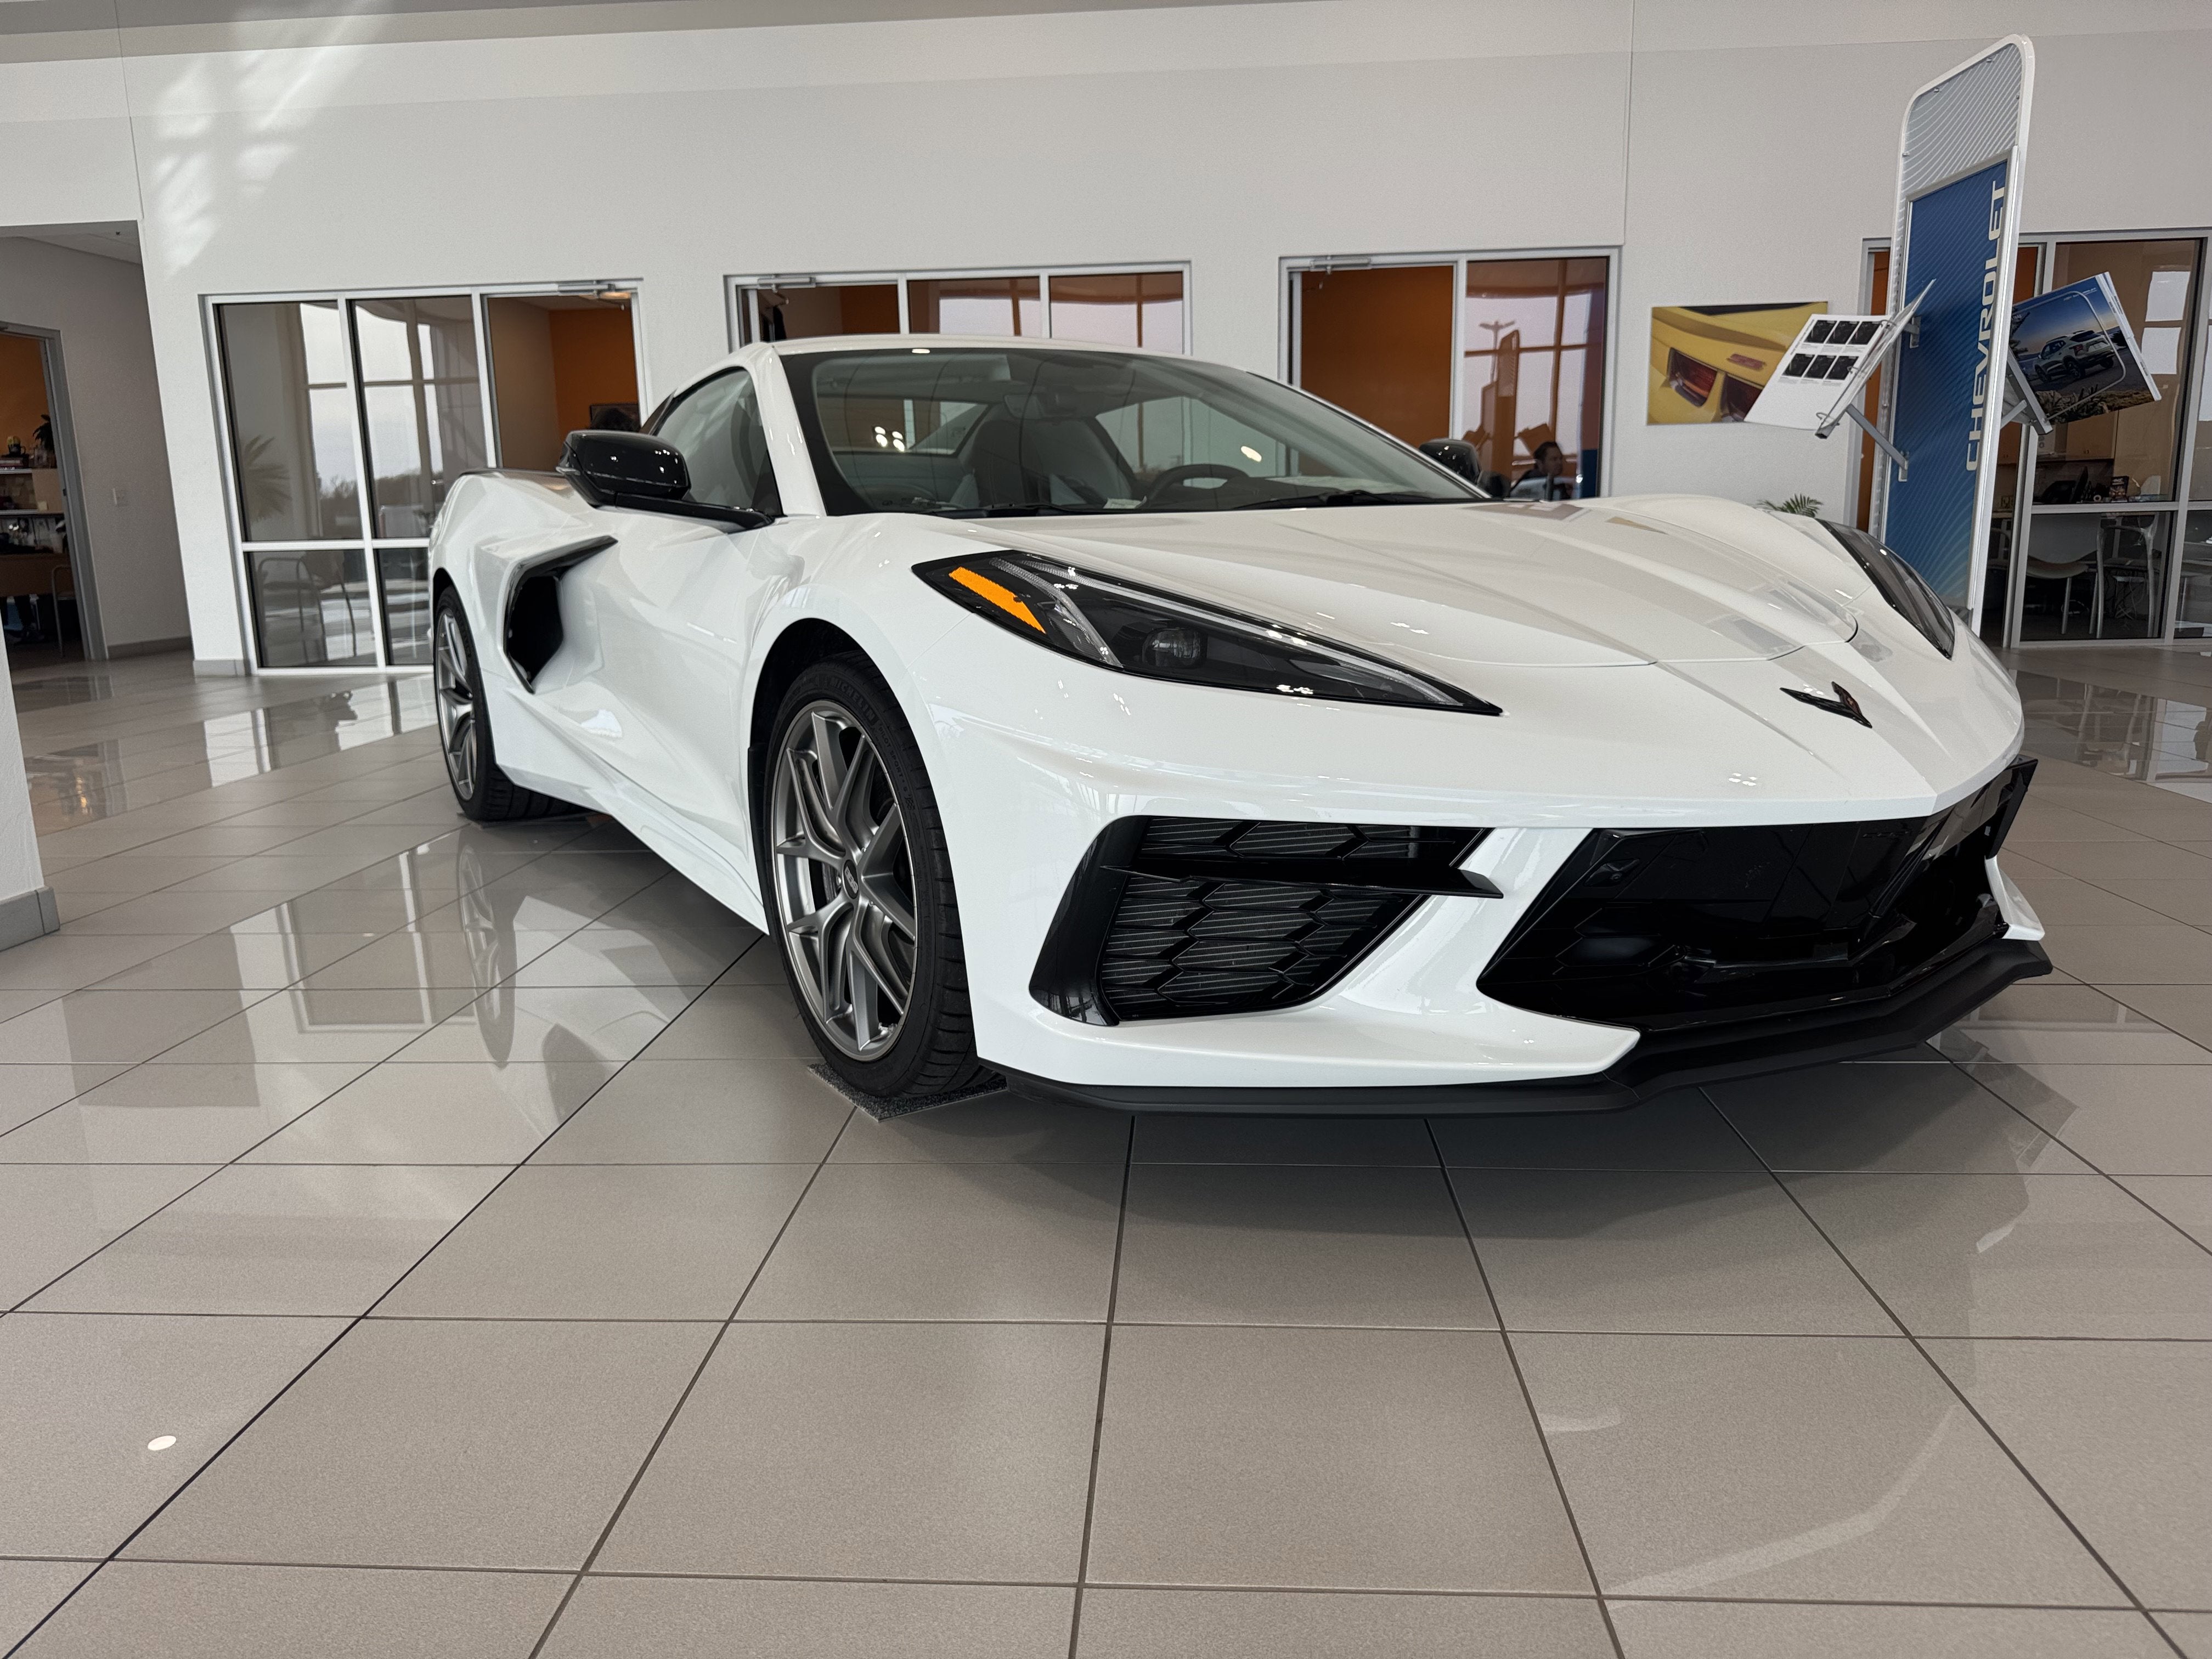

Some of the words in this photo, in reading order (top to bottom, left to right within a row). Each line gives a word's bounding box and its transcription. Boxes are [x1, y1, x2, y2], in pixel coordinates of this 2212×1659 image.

[1966, 180, 2005, 471] CHEVROLET
[830, 676, 876, 721] MICHELIN
[878, 726, 891, 748] PILOT
[889, 750, 904, 777] SPORT
[845, 865, 859, 894] BBS
